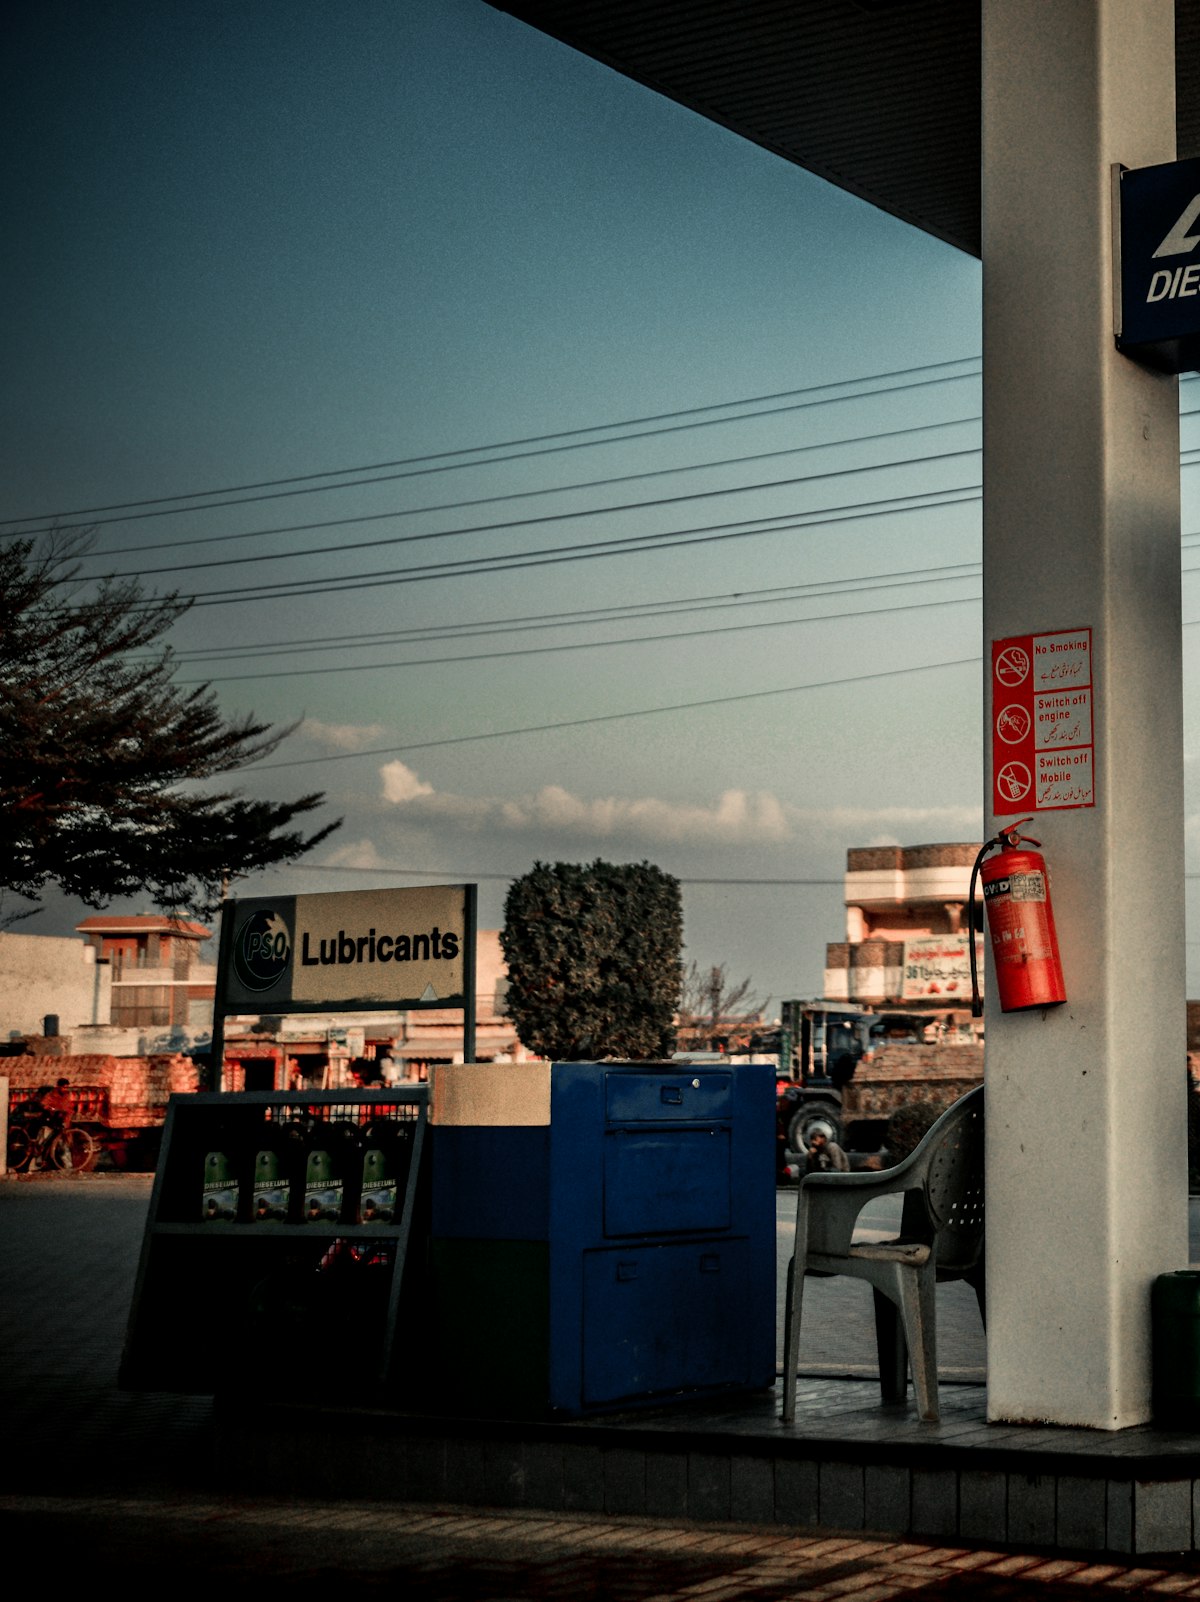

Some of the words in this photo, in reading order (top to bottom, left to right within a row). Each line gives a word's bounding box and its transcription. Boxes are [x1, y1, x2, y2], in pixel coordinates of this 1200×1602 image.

[1035, 645, 1047, 655] No
[1050, 640, 1087, 653] Smoking
[1038, 696, 1070, 709] Switch
[1072, 694, 1087, 705] off
[1039, 710, 1070, 723] engine
[1040, 755, 1072, 768] Switch
[1074, 753, 1088, 764] off
[1040, 771, 1071, 783] Mobile
[246, 931, 288, 961] PSO
[302, 926, 459, 966] Lubricants
